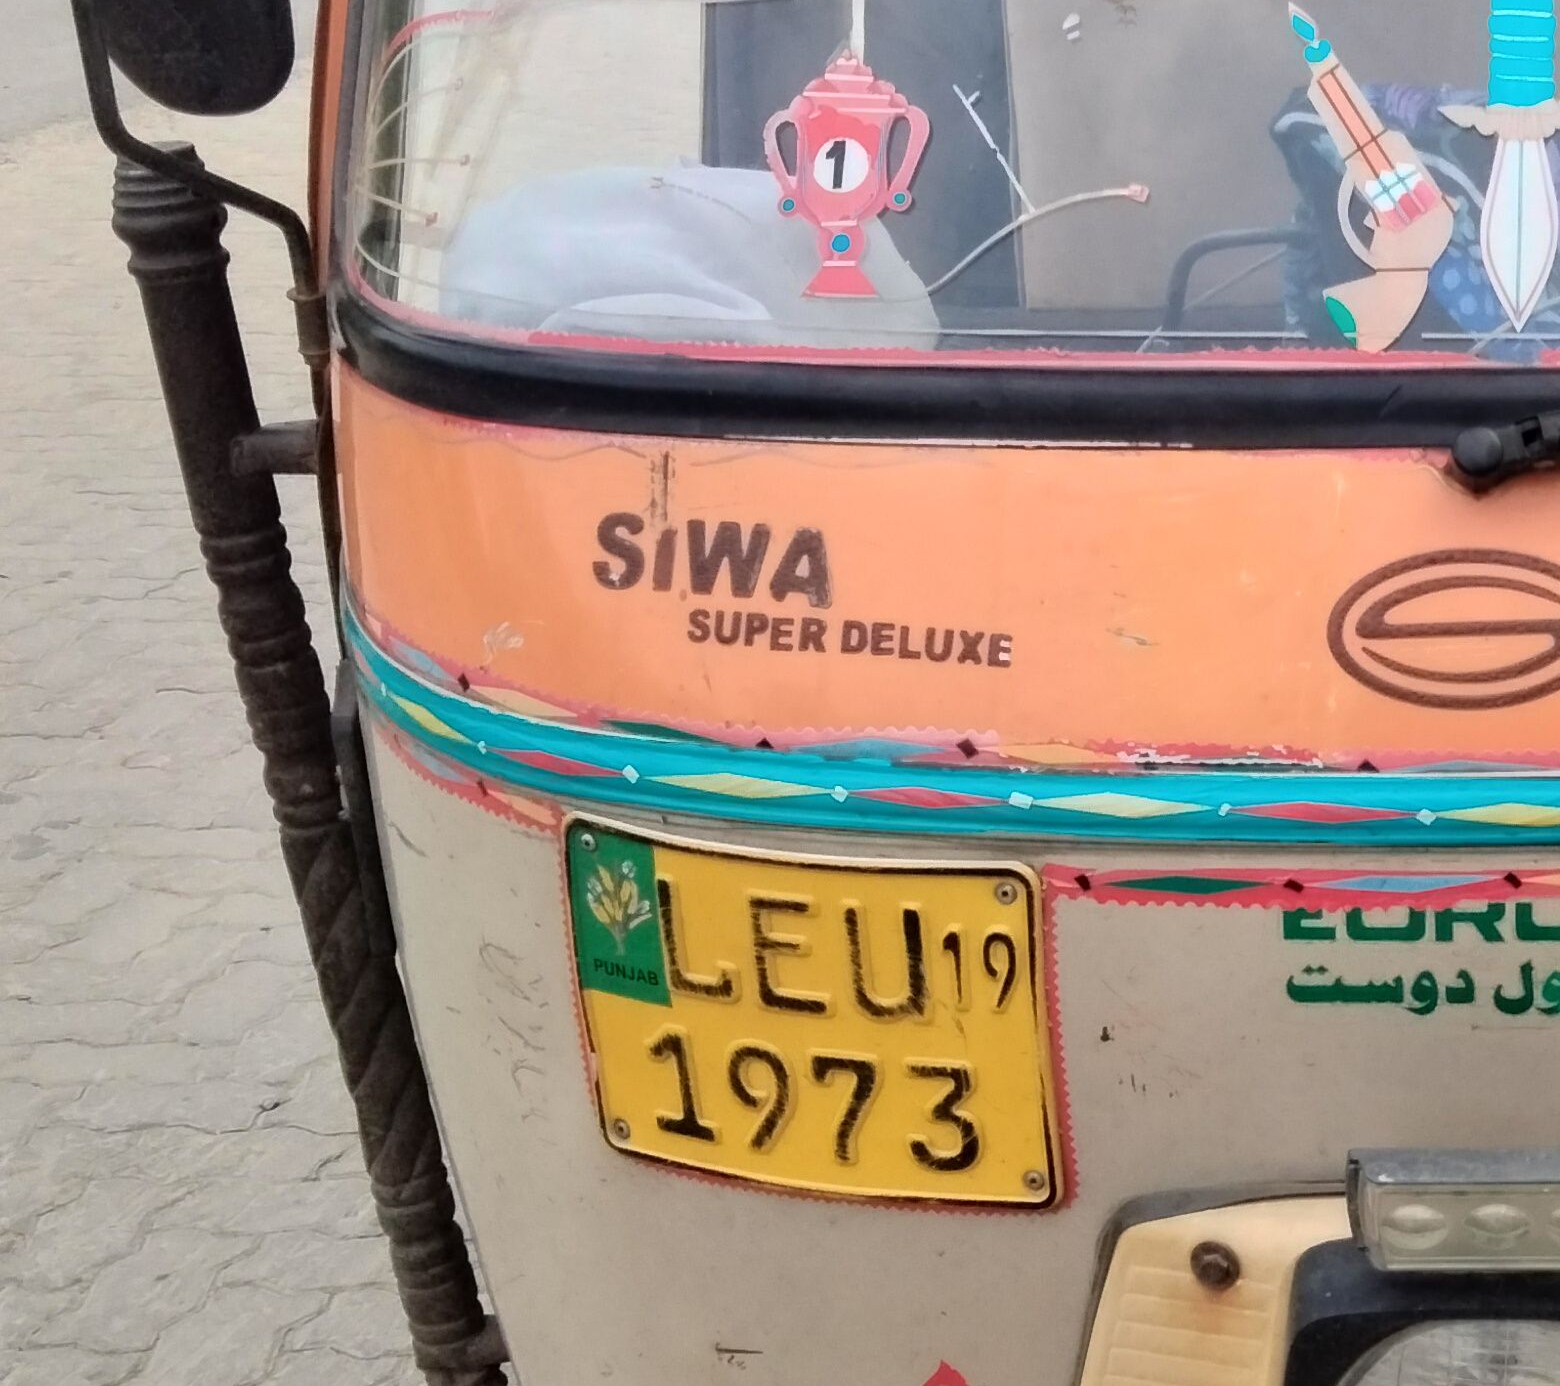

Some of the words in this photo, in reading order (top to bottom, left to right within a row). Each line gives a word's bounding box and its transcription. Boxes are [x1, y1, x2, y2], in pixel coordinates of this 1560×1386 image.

[825, 139, 847, 190] 1
[687, 608, 828, 655] SUPER
[840, 619, 1014, 669] DELUXE
[593, 958, 660, 987] PUNJAB
[655, 875, 930, 1019] LEU
[942, 927, 1018, 1011] 19
[1286, 965, 1476, 1015] دوست
[646, 1029, 982, 1173] 1973
